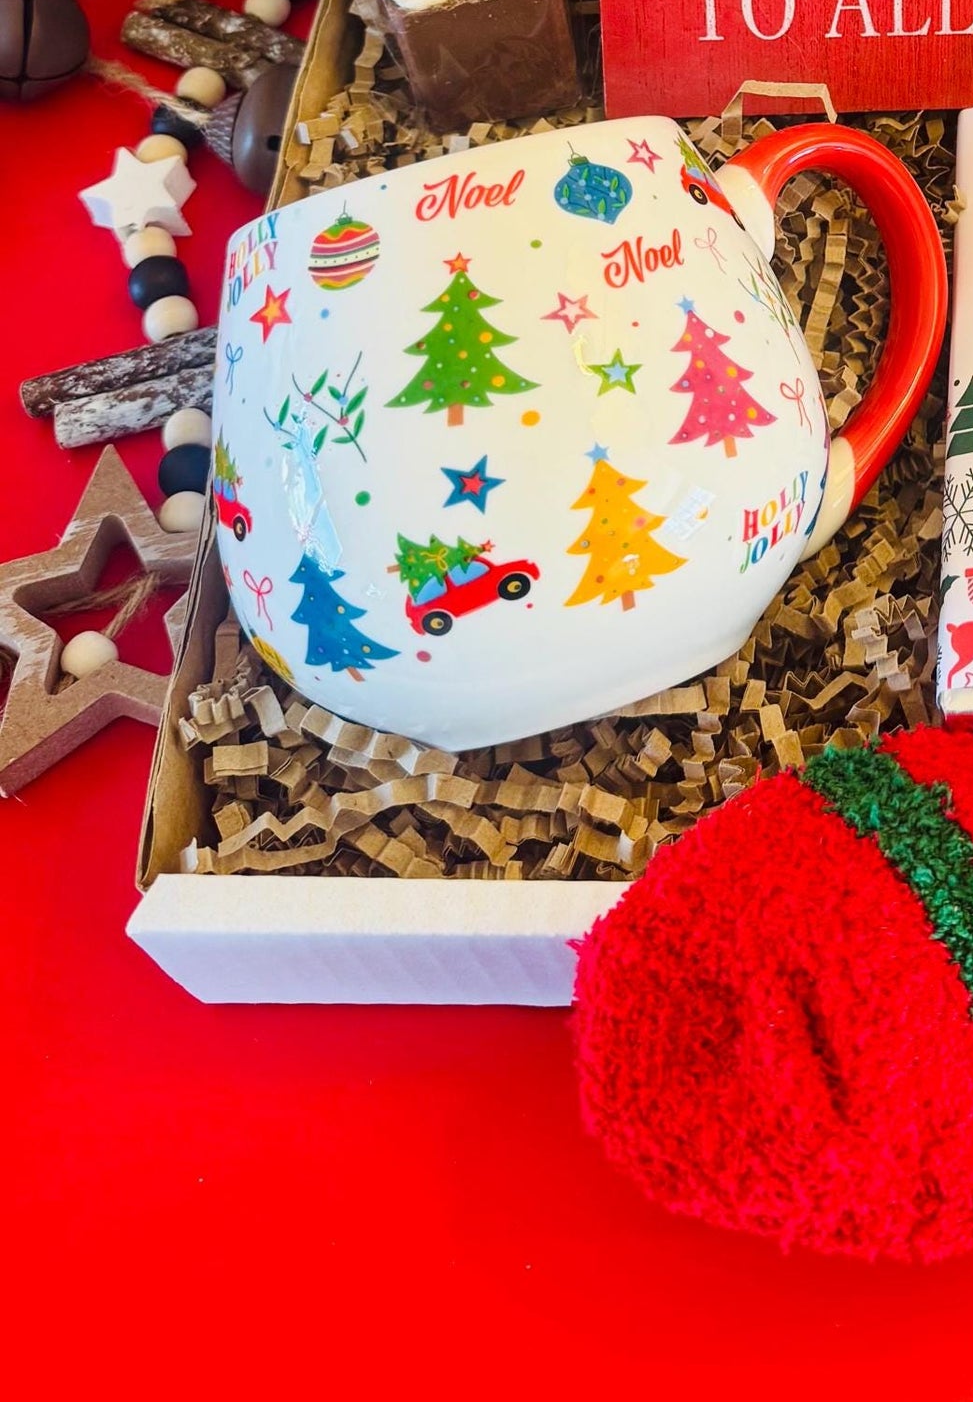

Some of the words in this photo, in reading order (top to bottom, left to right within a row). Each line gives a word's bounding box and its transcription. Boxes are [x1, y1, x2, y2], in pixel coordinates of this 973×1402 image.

[415, 168, 526, 222] Noel
[600, 228, 685, 289] Noel
[739, 500, 806, 574] JOLLY
[742, 470, 809, 543] HOLLY
